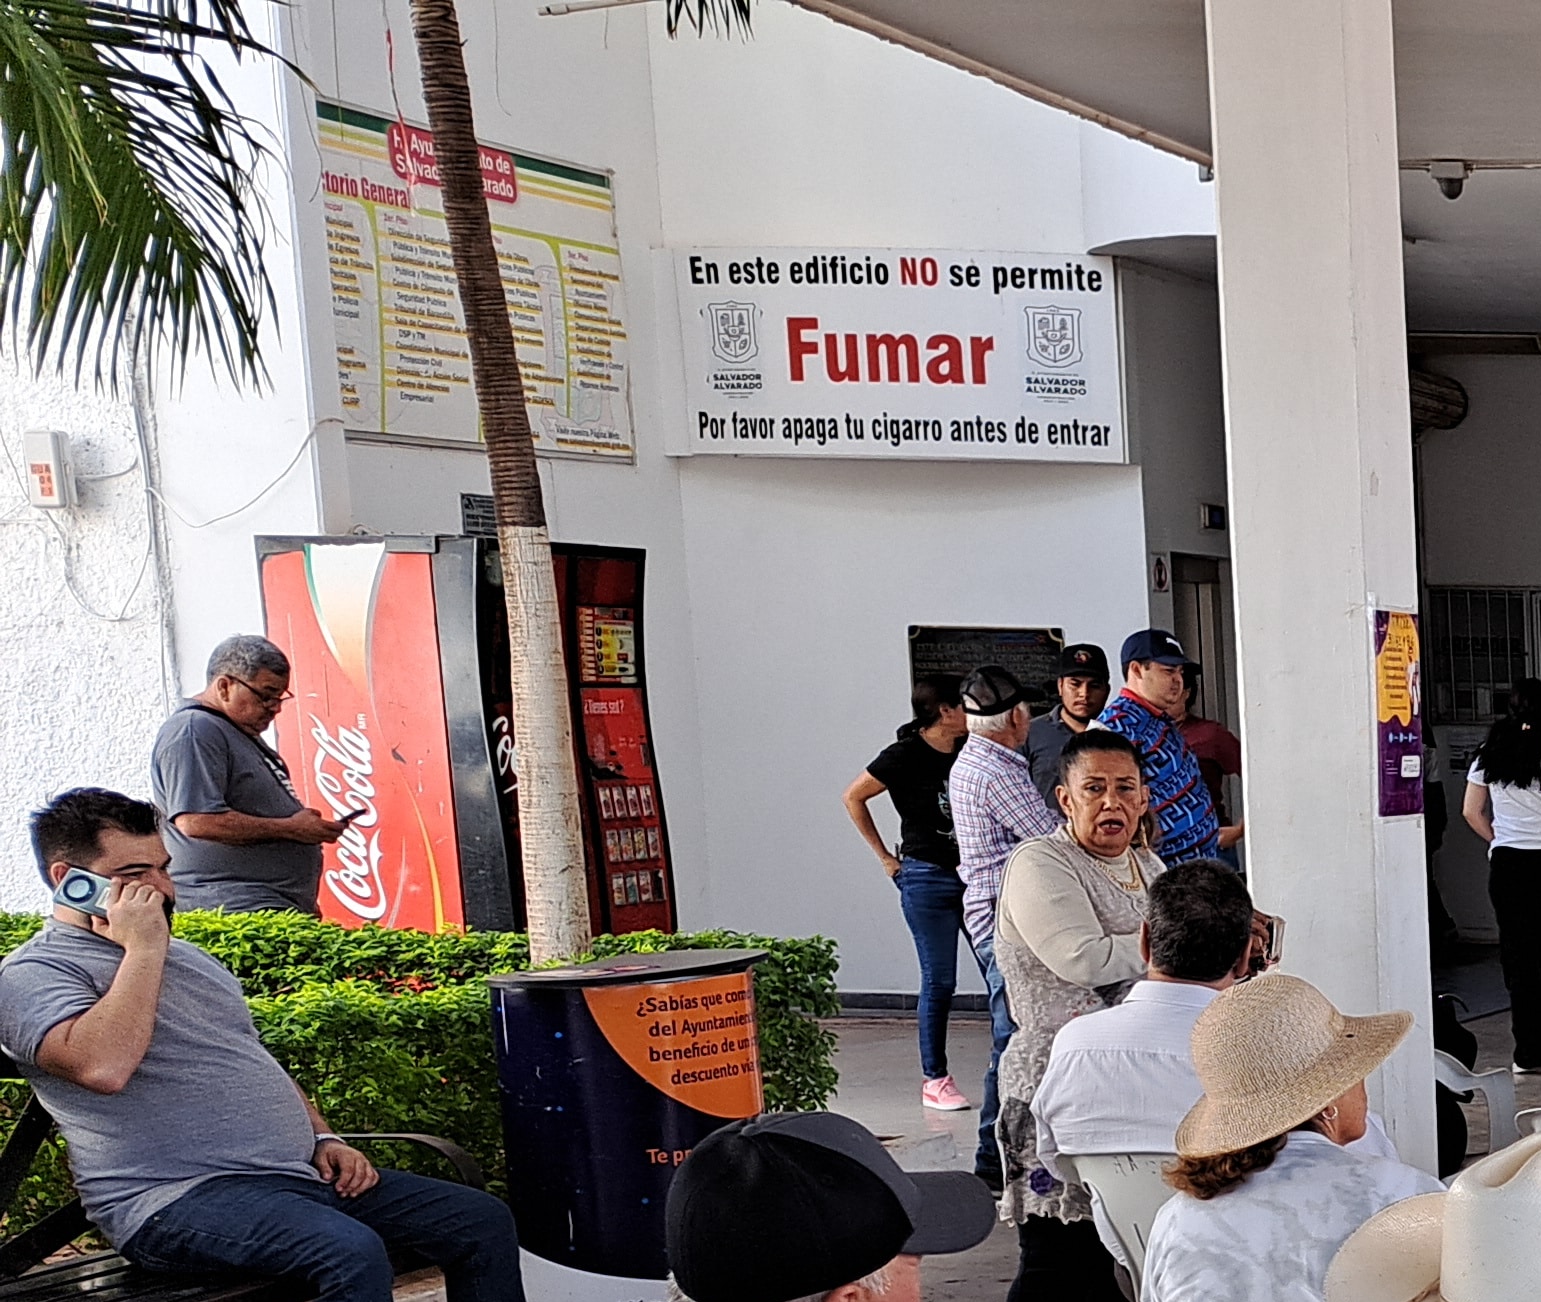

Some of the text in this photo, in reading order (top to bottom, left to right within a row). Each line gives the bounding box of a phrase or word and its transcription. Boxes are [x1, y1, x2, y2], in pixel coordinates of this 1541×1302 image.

[496, 156, 511, 174] de
[361, 176, 411, 210] General
[690, 256, 1103, 294] En este edificio NO se permite
[786, 317, 995, 385] Fumar
[1026, 377, 1086, 386] SALVADOR
[1026, 386, 1087, 395] ALVARADO
[698, 411, 1110, 447] Por favor apaga tu cigarro antes de entrar
[635, 988, 754, 1013] ¿Sabías que com
[648, 1011, 755, 1038] del Ayuntamien
[649, 1042, 718, 1062] beneficio
[721, 1039, 736, 1055] de
[671, 1064, 739, 1086] descuento
[647, 1149, 669, 1164] Te
